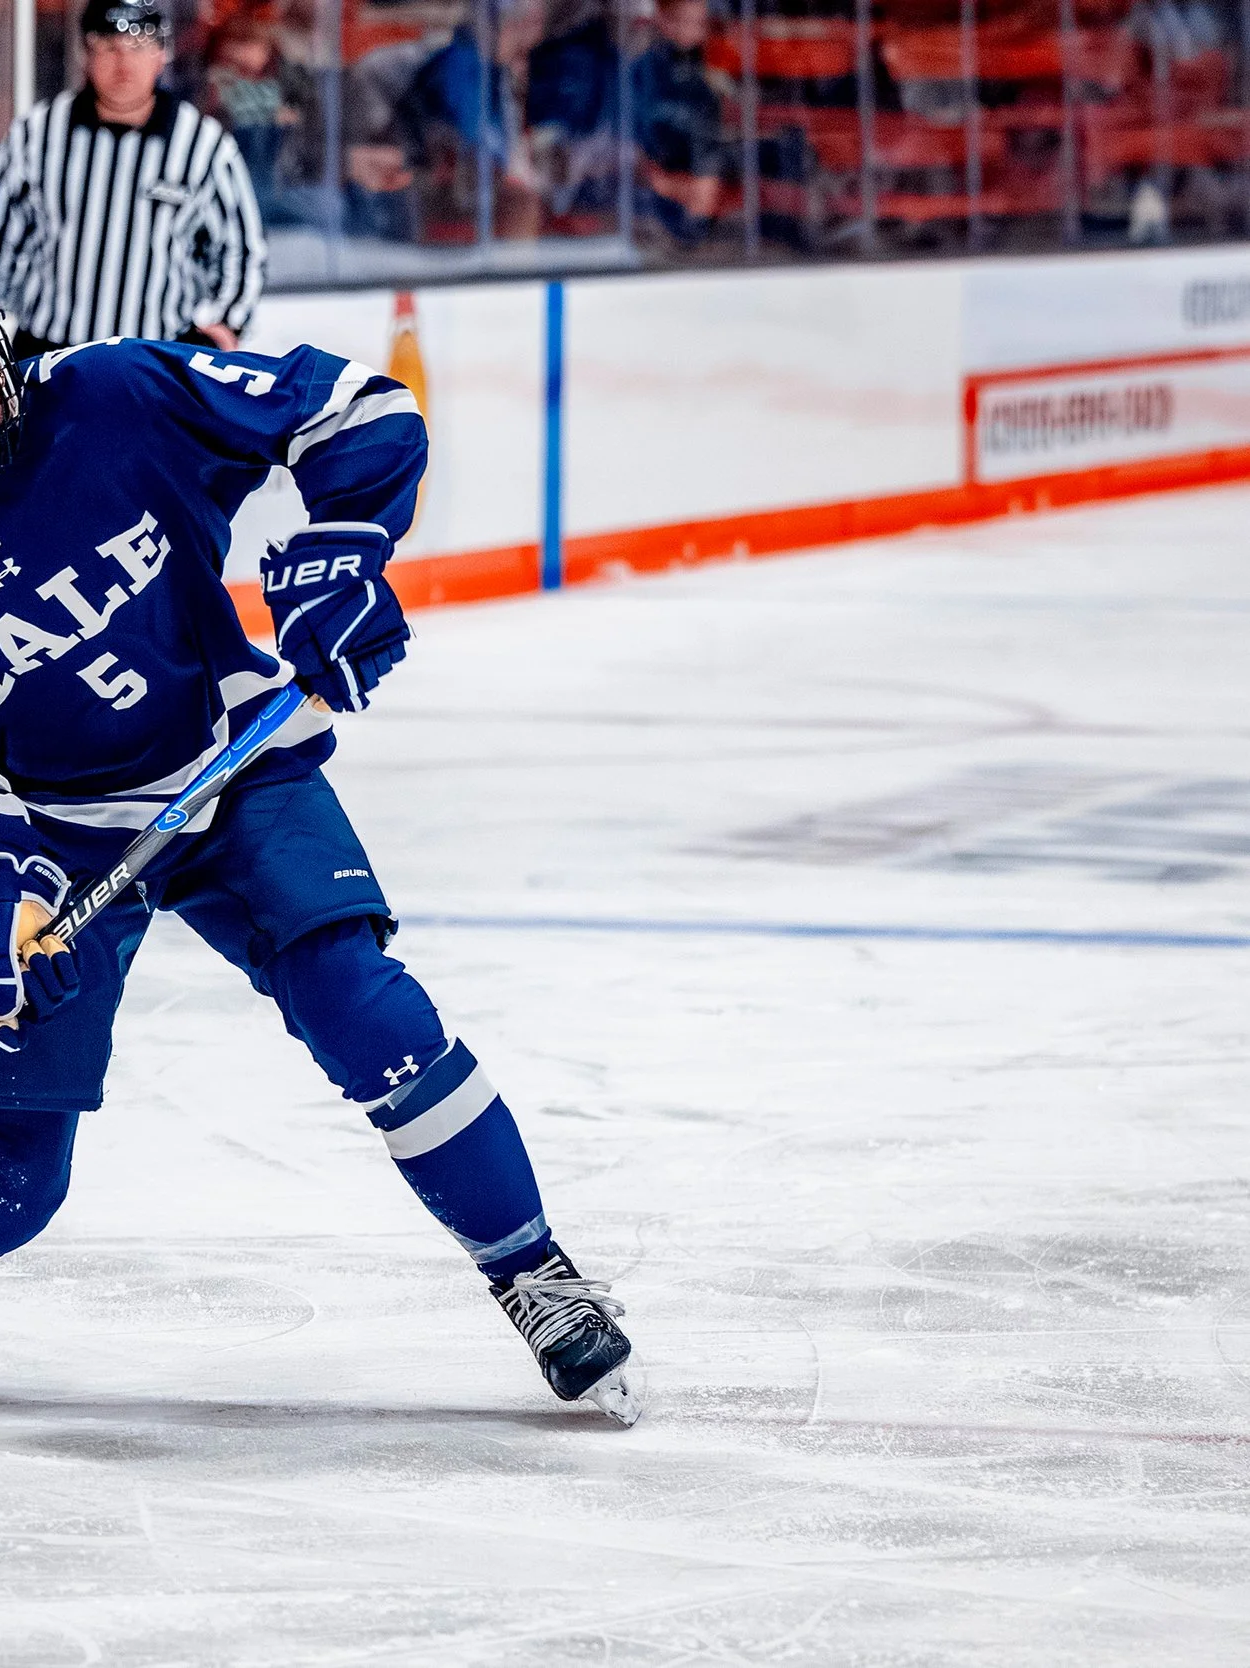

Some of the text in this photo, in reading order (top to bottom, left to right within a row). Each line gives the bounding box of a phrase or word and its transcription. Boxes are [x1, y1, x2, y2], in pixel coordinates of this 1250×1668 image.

[188, 351, 277, 397] 5
[76, 651, 148, 711] 5
[34, 864, 63, 889] BAUER
[333, 868, 370, 880] BAUER
[53, 862, 131, 942] AUER
